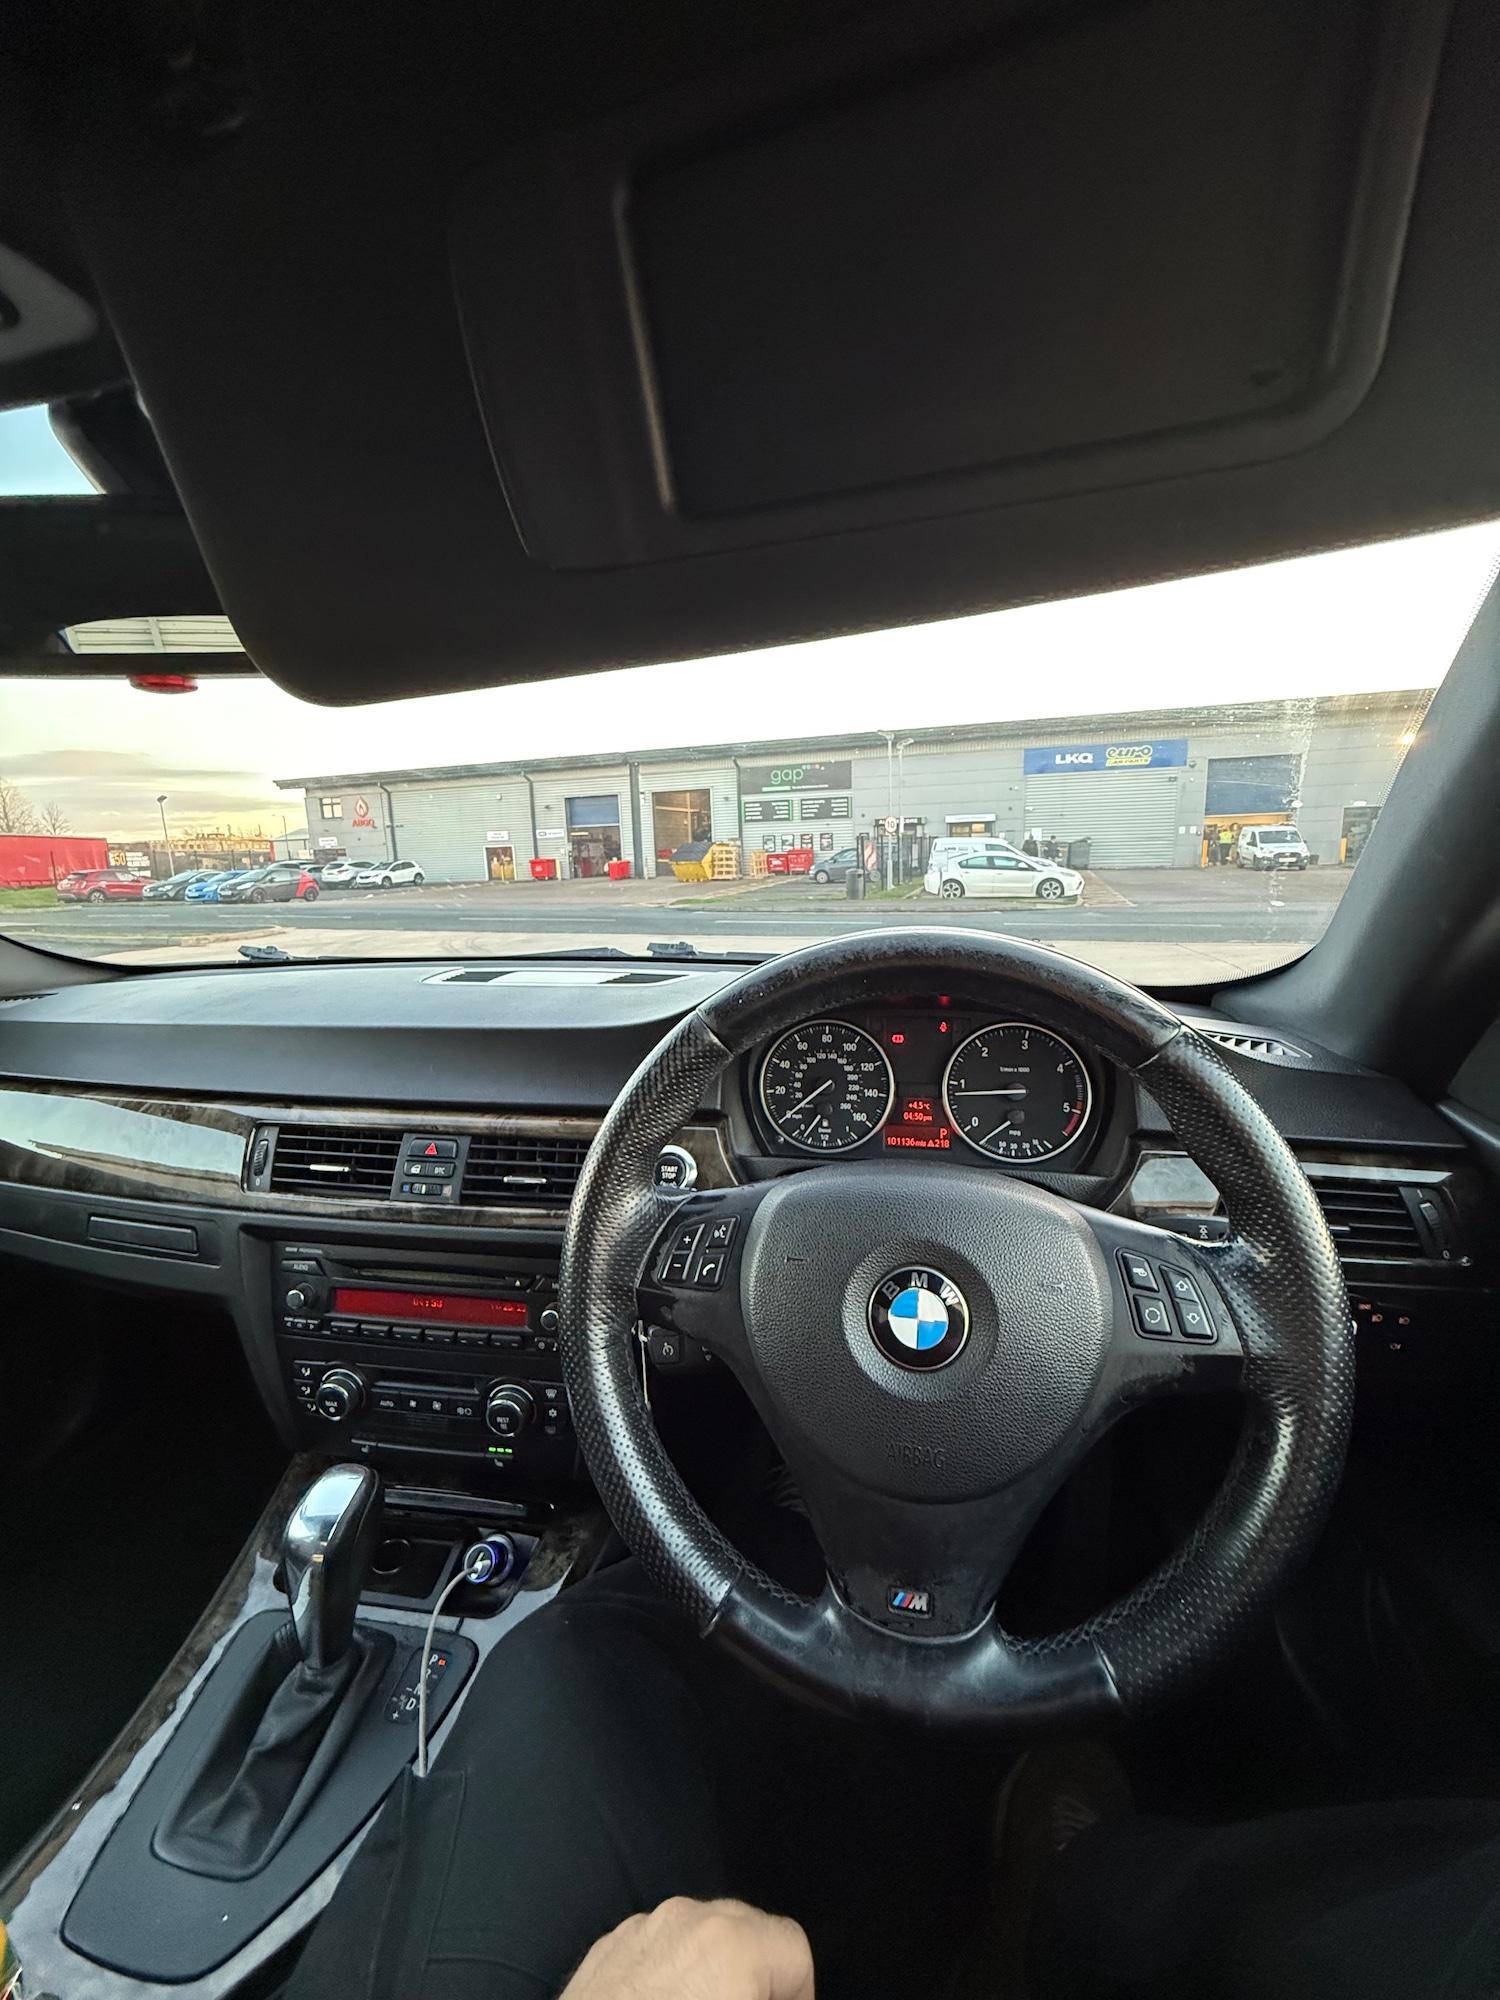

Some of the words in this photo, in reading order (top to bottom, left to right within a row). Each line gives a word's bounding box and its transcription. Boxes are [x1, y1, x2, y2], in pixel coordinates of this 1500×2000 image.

[1106, 746, 1152, 759] euro
[1055, 752, 1093, 764] LKQ
[770, 768, 804, 785] gap
[821, 1034, 833, 1043] 80
[797, 1042, 808, 1050] 60
[843, 1043, 857, 1051] 100
[1021, 1040, 1028, 1050] 3
[981, 1047, 988, 1057] 2
[780, 1060, 790, 1068] 40
[860, 1062, 874, 1071] 120
[1056, 1063, 1064, 1073] 4
[960, 1079, 965, 1089] 1
[775, 1086, 786, 1094] 20
[864, 1089, 878, 1098] 140
[1063, 1102, 1070, 1112] 5
[852, 1112, 867, 1121] 160
[971, 1116, 978, 1127] 0
[940, 1128, 948, 1138] P
[934, 1139, 950, 1148] 218
[434, 1166, 446, 1174] DTC
[881, 1272, 960, 1306] BMW
[886, 1442, 946, 1468] AIRBAG
[429, 1654, 438, 1665] P
[405, 1697, 416, 1710] D
